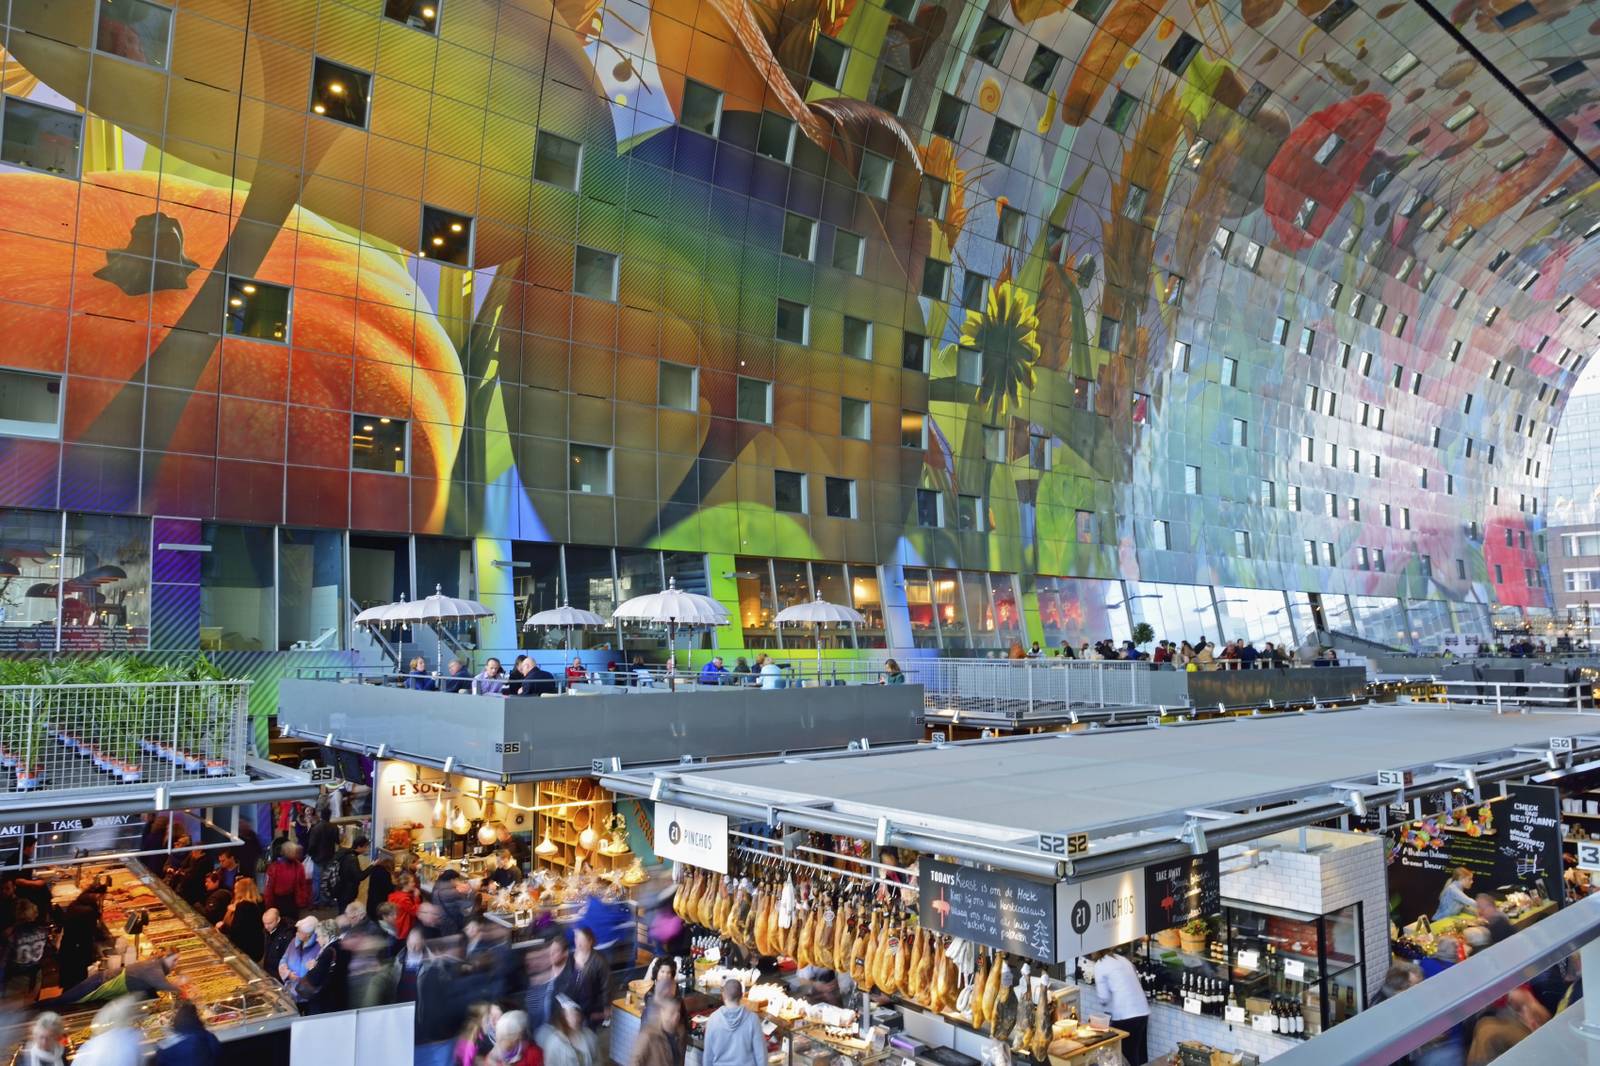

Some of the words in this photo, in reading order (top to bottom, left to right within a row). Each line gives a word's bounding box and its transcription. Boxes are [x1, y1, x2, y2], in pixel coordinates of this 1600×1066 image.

[503, 742, 519, 753] 86
[593, 760, 603, 773] 52
[311, 768, 332, 781] 89
[1379, 771, 1401, 785] 51
[392, 785, 405, 796] LE
[51, 819, 81, 831] TAKE
[671, 826, 678, 841] 21
[684, 829, 712, 850] PINCHOS
[1040, 834, 1065, 854] 52
[1067, 834, 1087, 854] 52
[930, 870, 955, 886] TODAYS
[1155, 870, 1167, 882] TAKE
[1095, 895, 1134, 923] PINCHOS
[1075, 907, 1086, 927] 21
